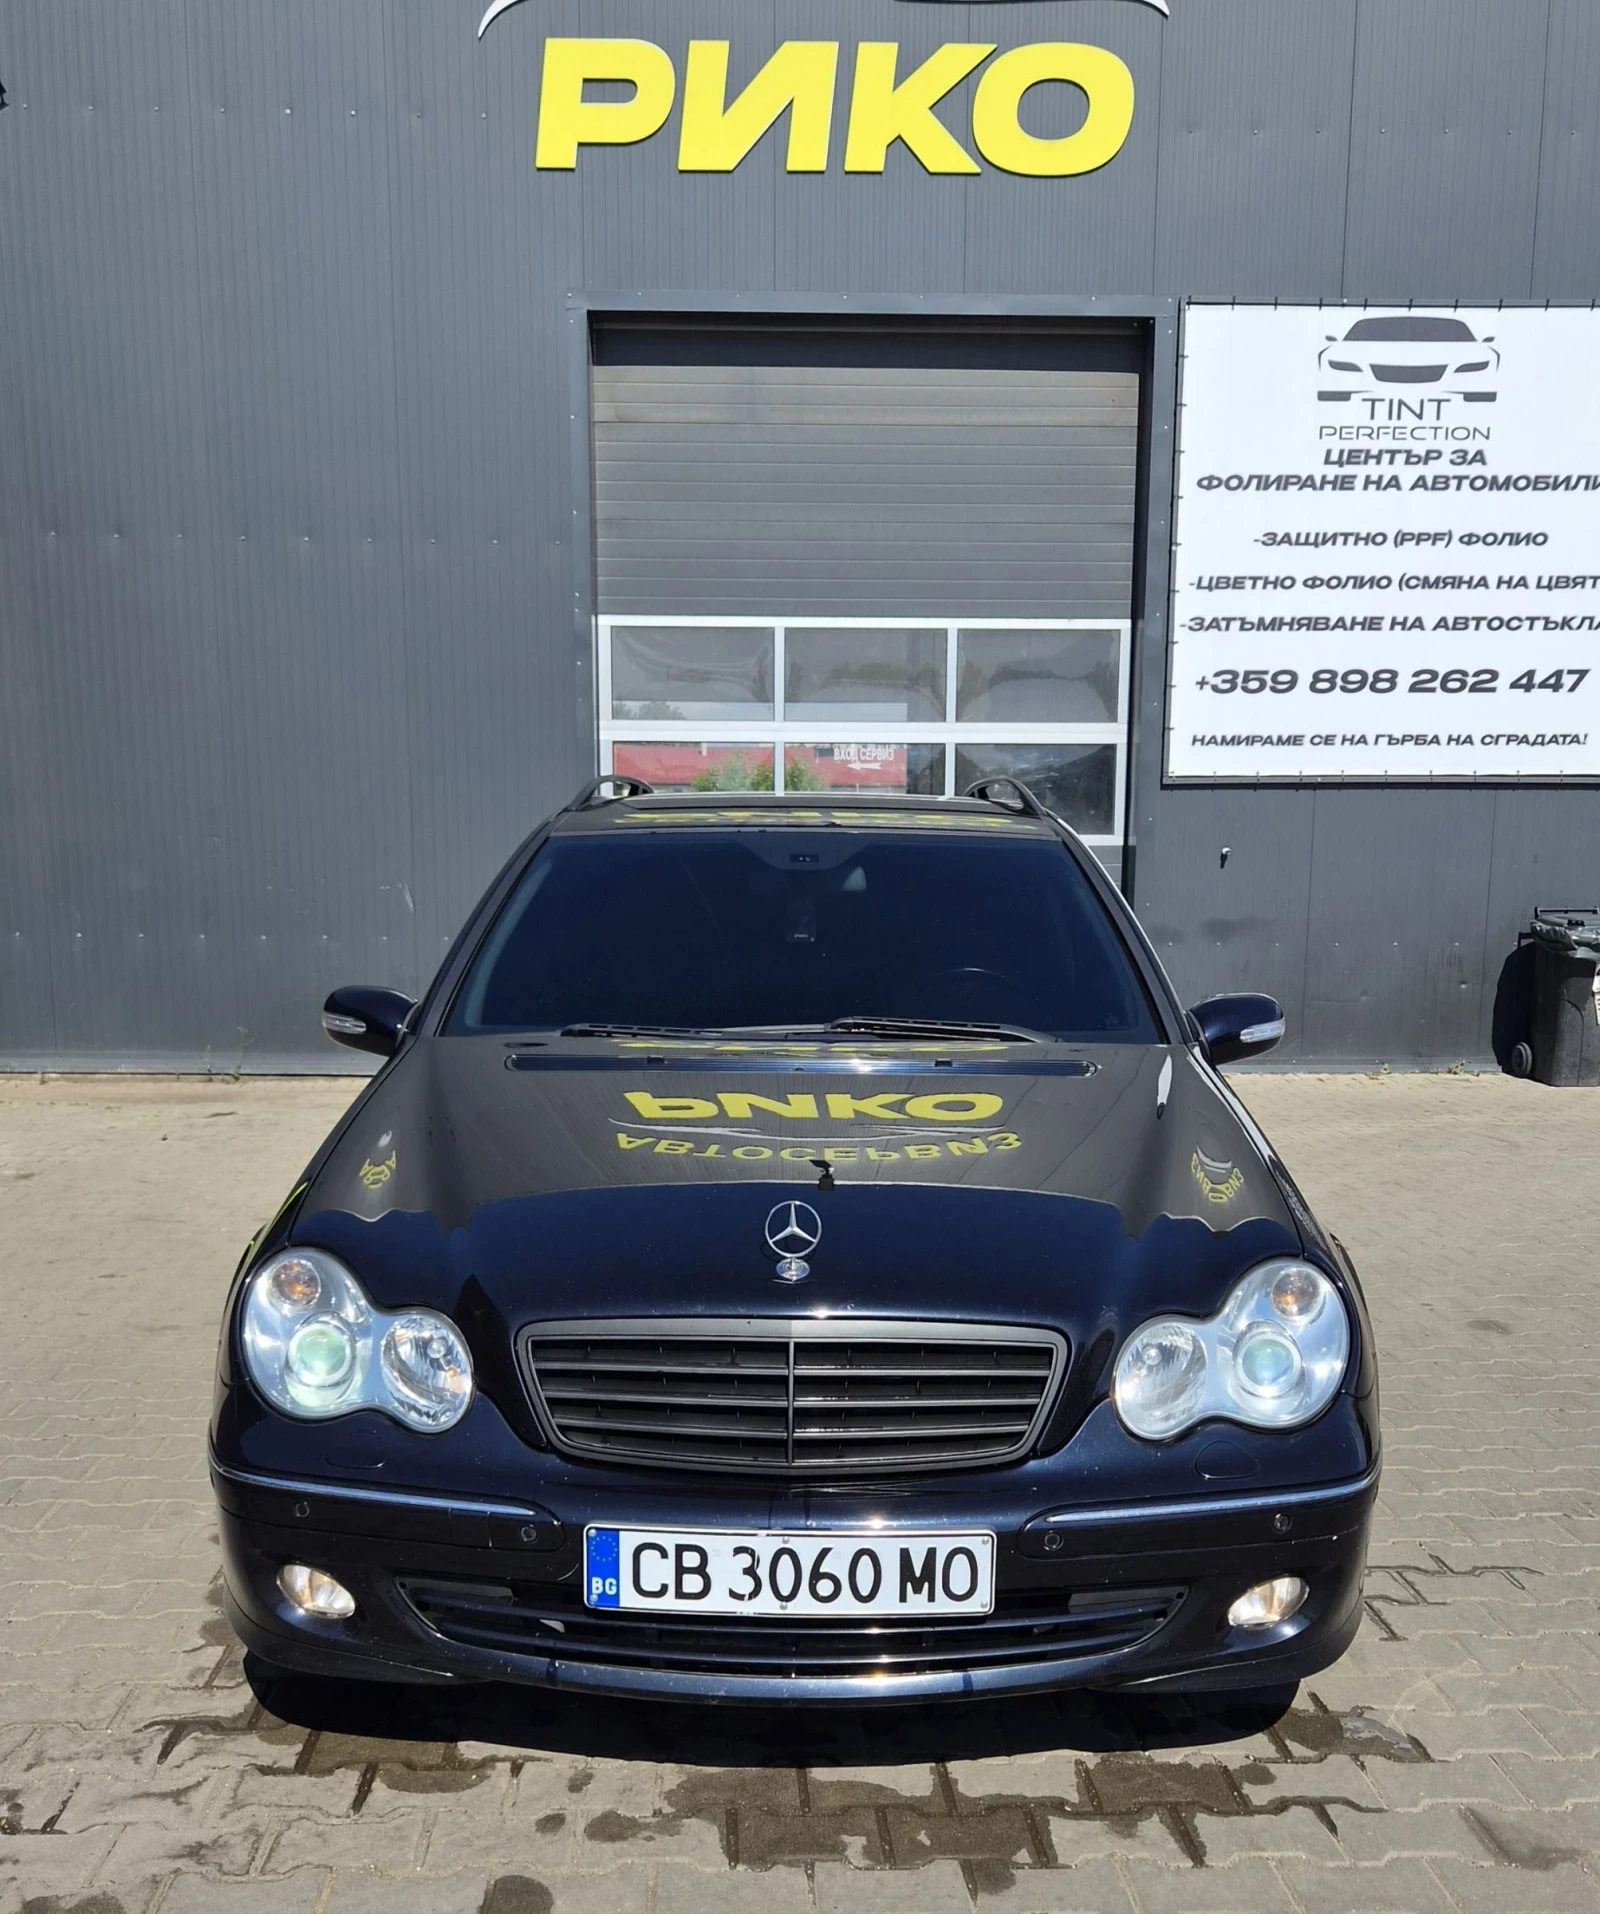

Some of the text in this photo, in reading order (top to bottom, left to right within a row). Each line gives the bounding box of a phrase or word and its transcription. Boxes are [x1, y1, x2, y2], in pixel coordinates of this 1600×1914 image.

[536, 38, 1135, 177] РИКО
[1361, 397, 1452, 421] TINT
[1319, 425, 1491, 441] PERFECTION
[1323, 448, 1488, 468] ЦЕНТЪР ЗА
[1196, 474, 1357, 492] ФОЛИРАНЕ
[1363, 474, 1402, 491] НА
[1253, 529, 1549, 549] -ЗАЩИТНО (PPF) ФОЛИО
[1189, 572, 1600, 592] -ЦВЕТНО ФОЛИО (СМЯНА НА ЦВЯТ
[1180, 616, 1385, 632] -ЗАТЪМНЯВАНЕ
[1389, 616, 1426, 632] НА
[1195, 668, 1591, 695] +359 898 262 447
[1191, 733, 1589, 747] НАМИРАМЕ СЕ НА ГЪРБА НА СГРАДАТА!
[860, 747, 895, 761] СЕРВИЗ
[591, 1542, 980, 1603] BG CB 3060 MO
